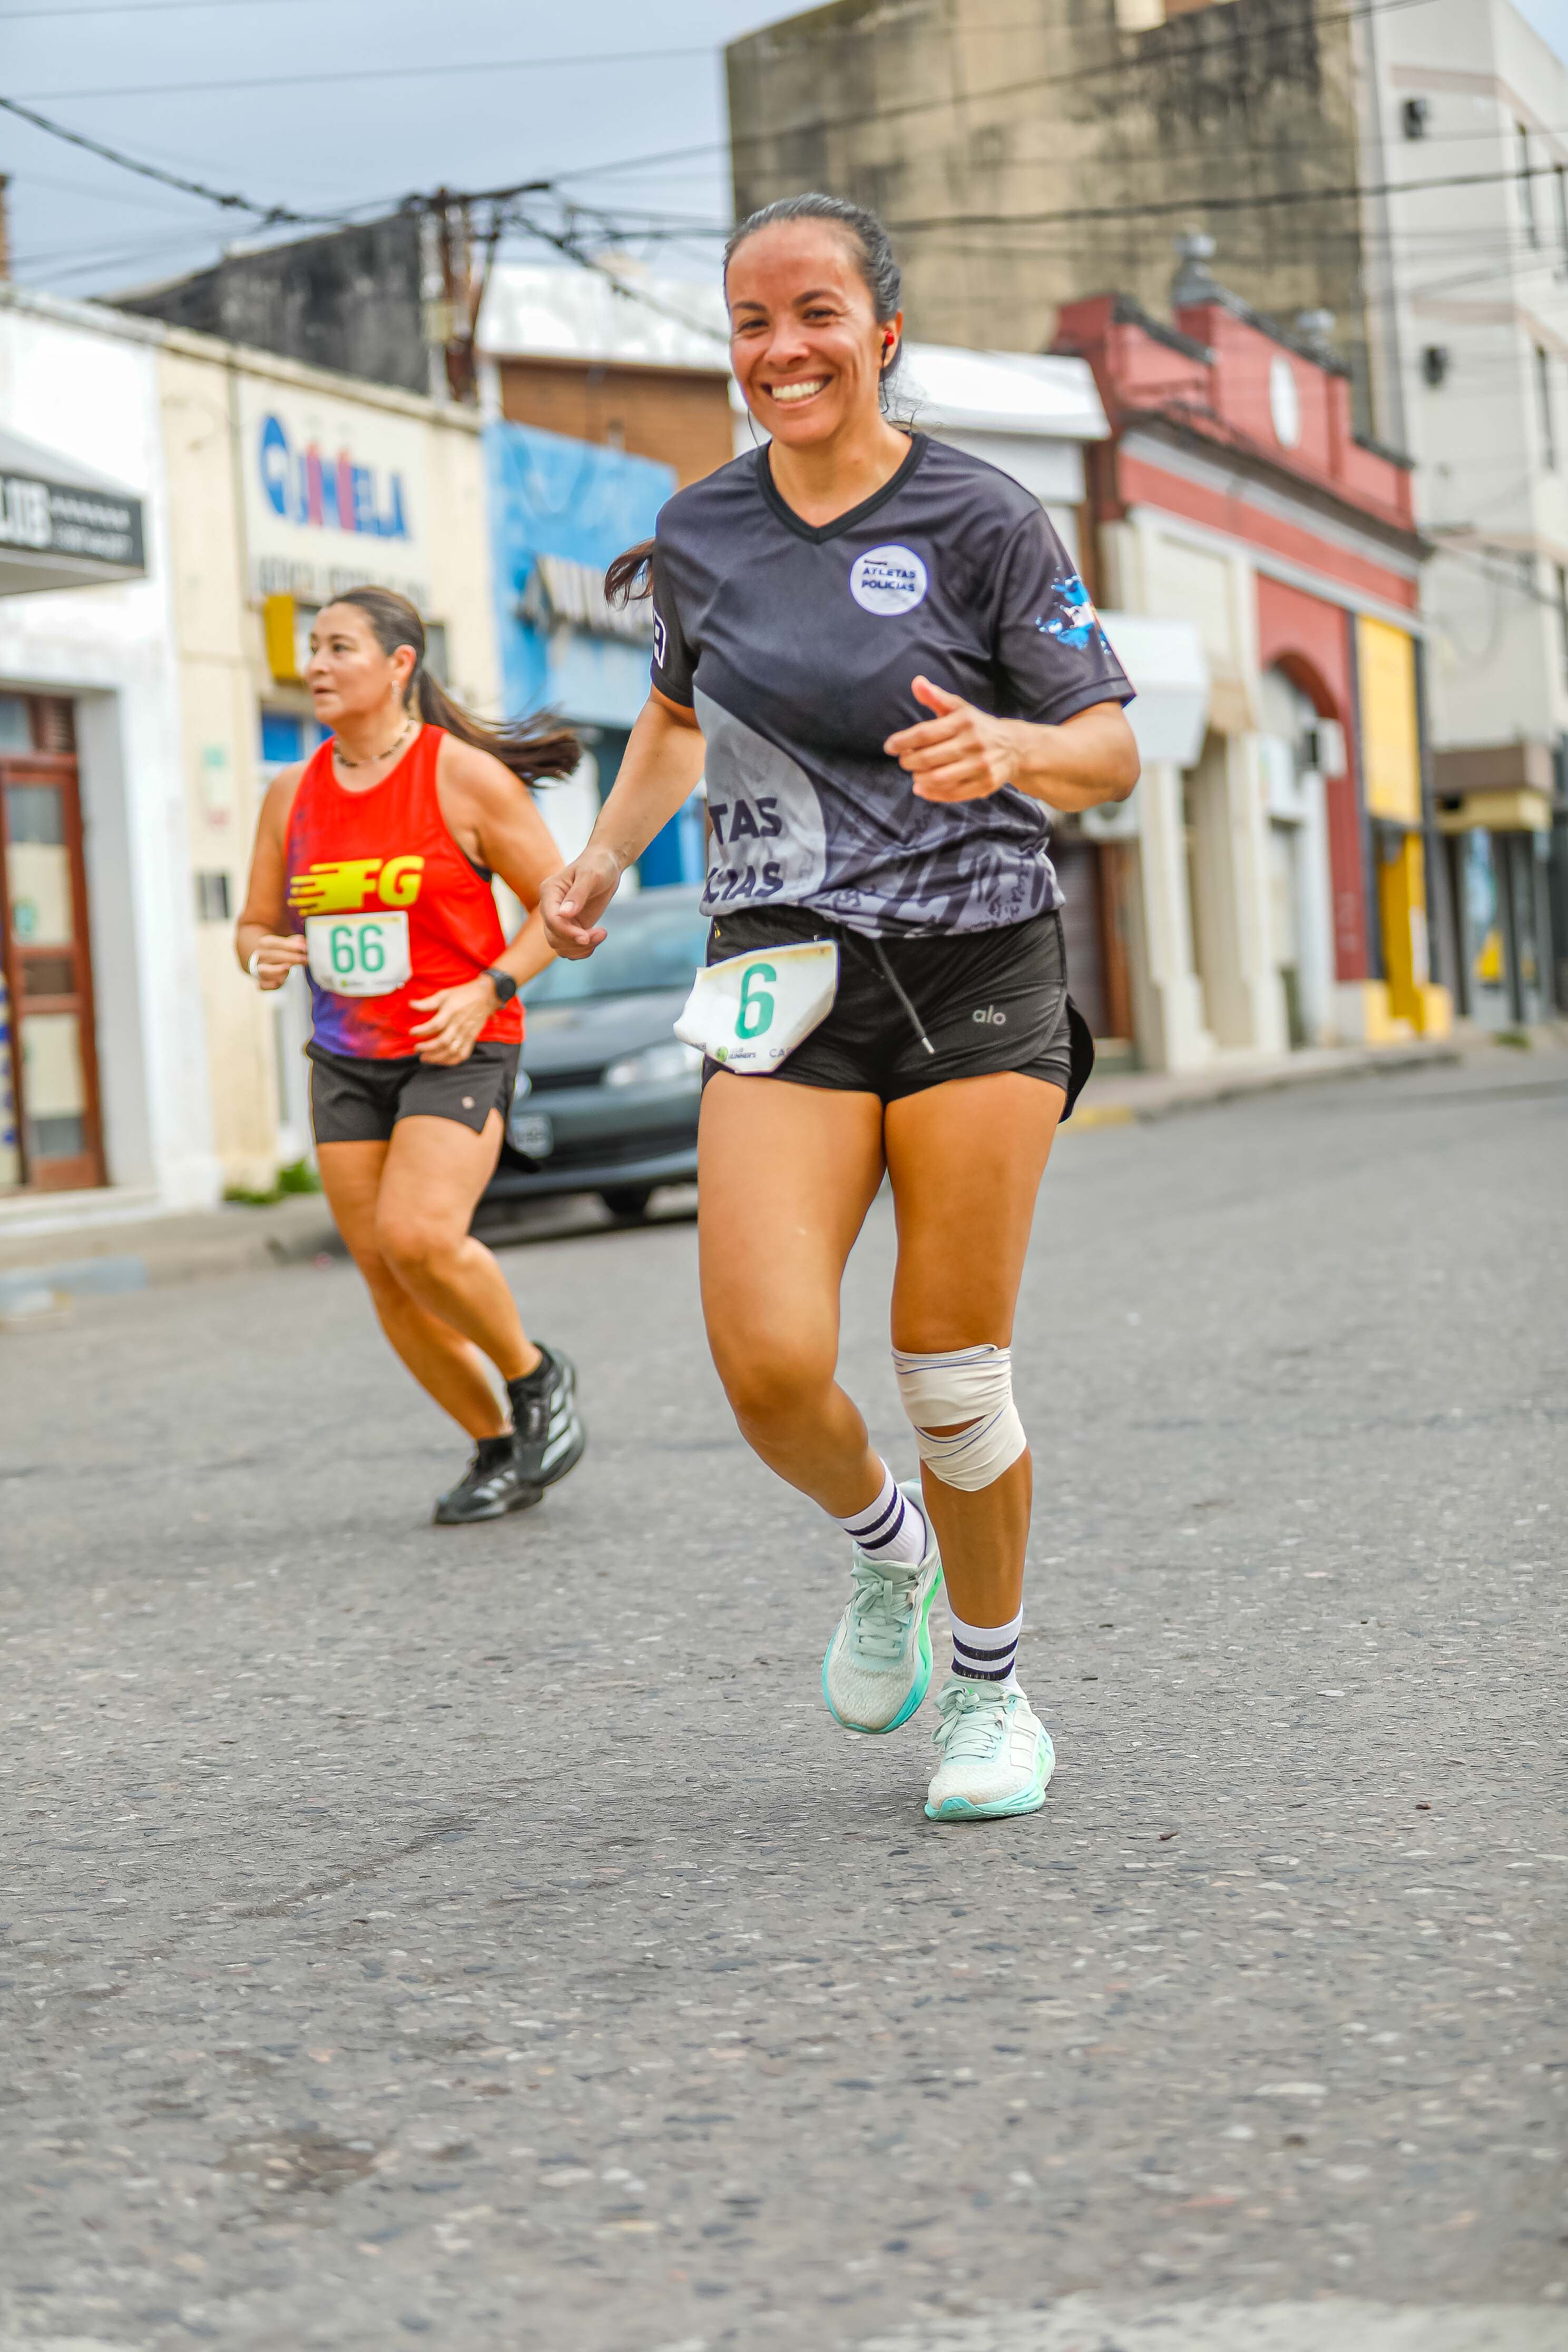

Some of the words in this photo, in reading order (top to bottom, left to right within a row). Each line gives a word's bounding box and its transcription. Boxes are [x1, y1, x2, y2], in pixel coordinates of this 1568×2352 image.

[861, 580, 915, 591] POLICIAS
[863, 567, 916, 578] ATLETAS
[708, 797, 782, 845] TAS
[330, 923, 385, 974] 66
[735, 962, 777, 1040] 6
[972, 1004, 1006, 1025] alo
